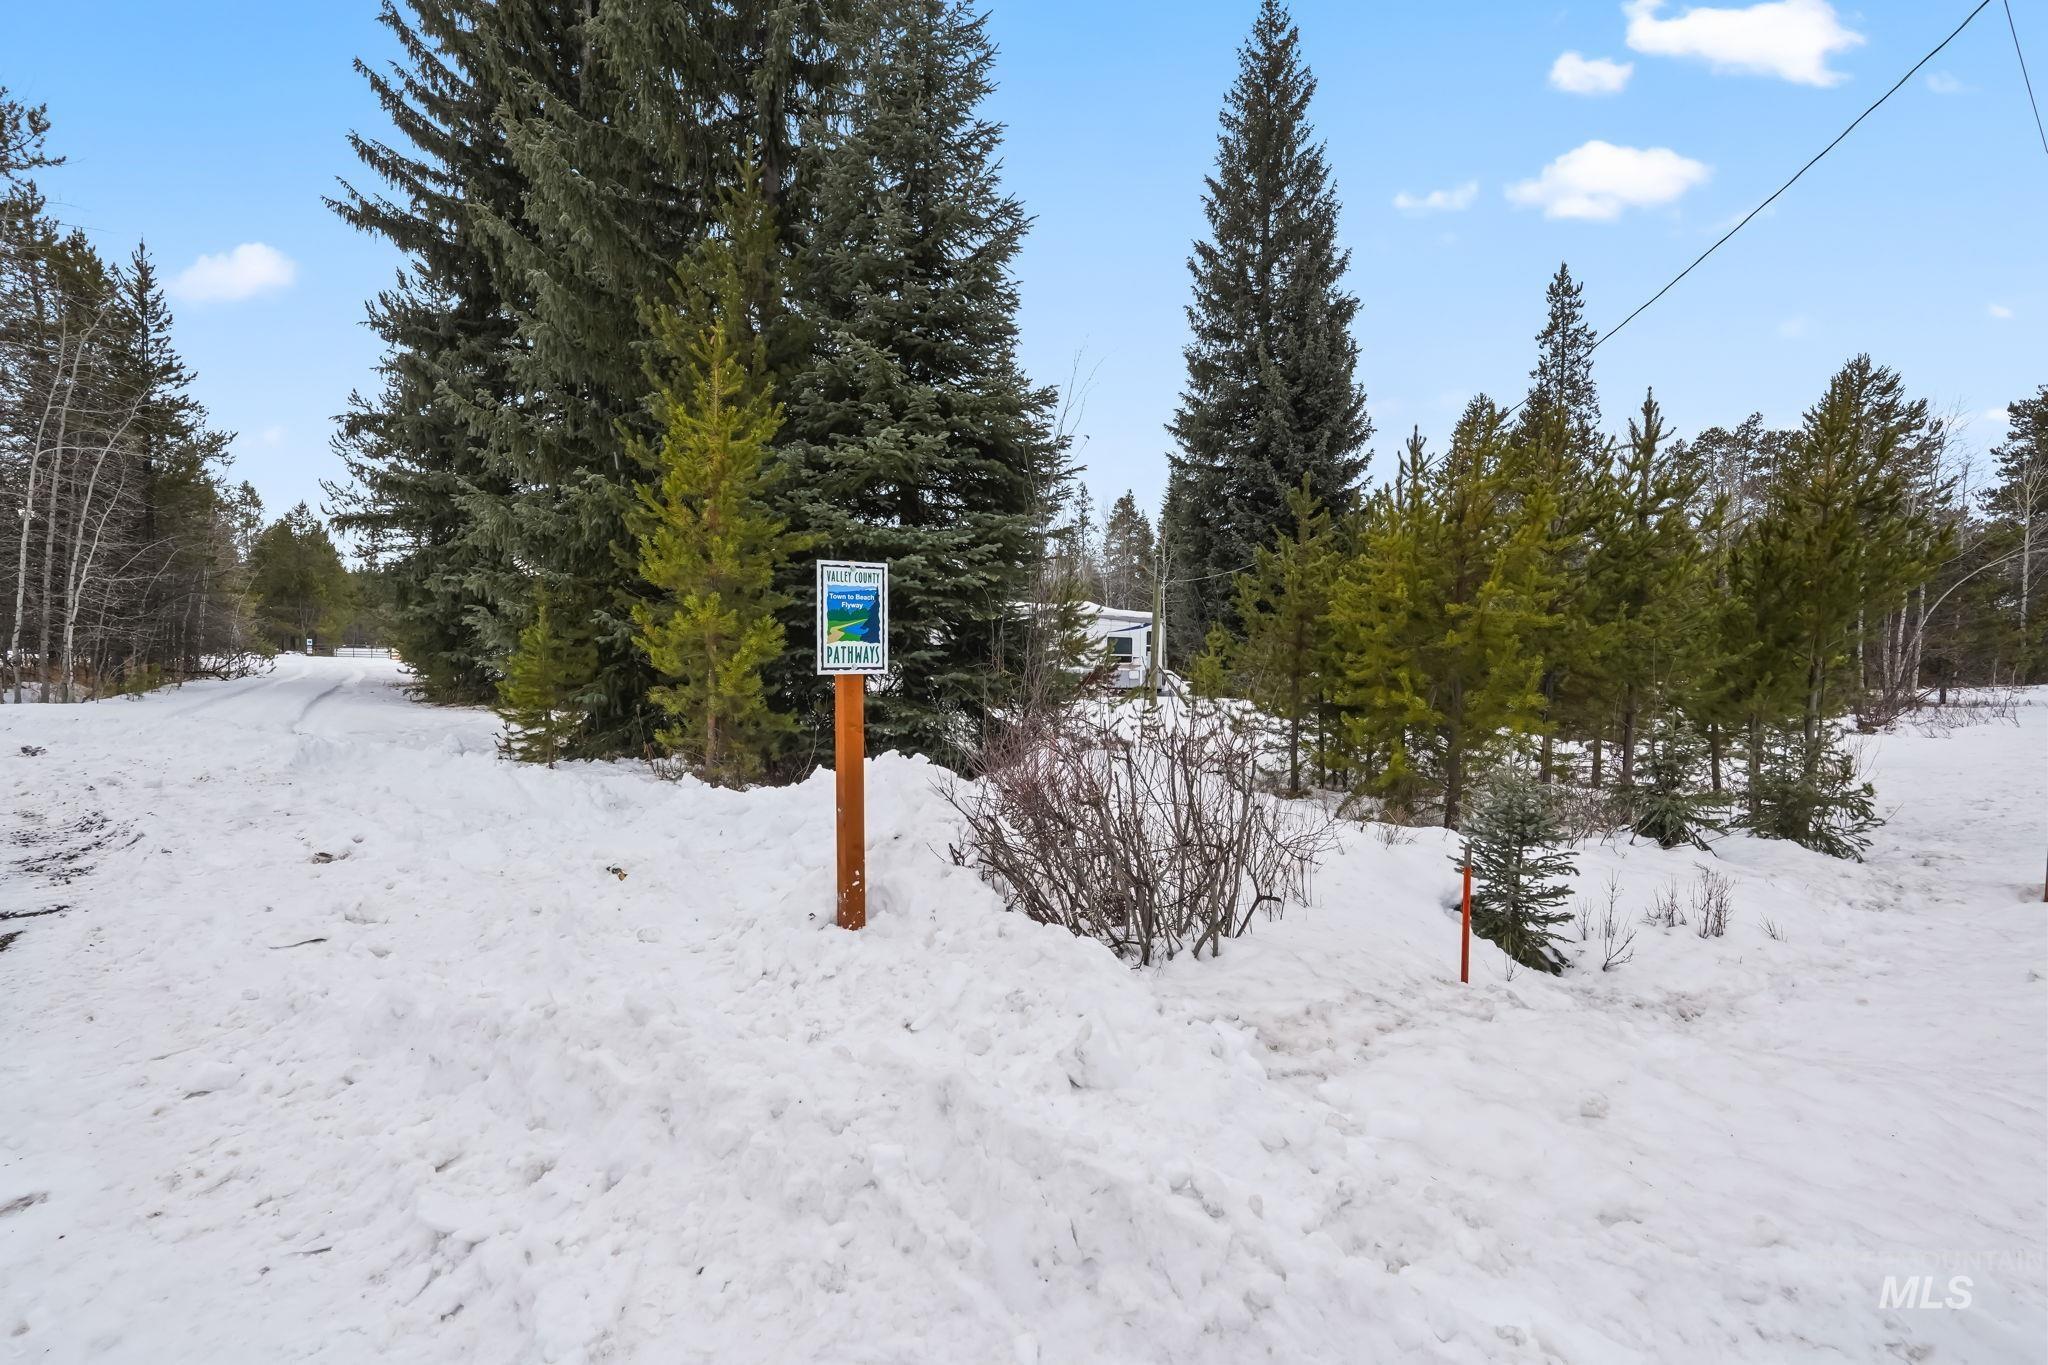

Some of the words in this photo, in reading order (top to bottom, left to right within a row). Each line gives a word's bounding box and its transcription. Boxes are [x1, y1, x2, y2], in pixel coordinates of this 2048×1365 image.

[827, 570, 851, 583] VALLEY
[855, 571, 880, 583] COUNTY
[827, 646, 880, 664] PATHWAYS
